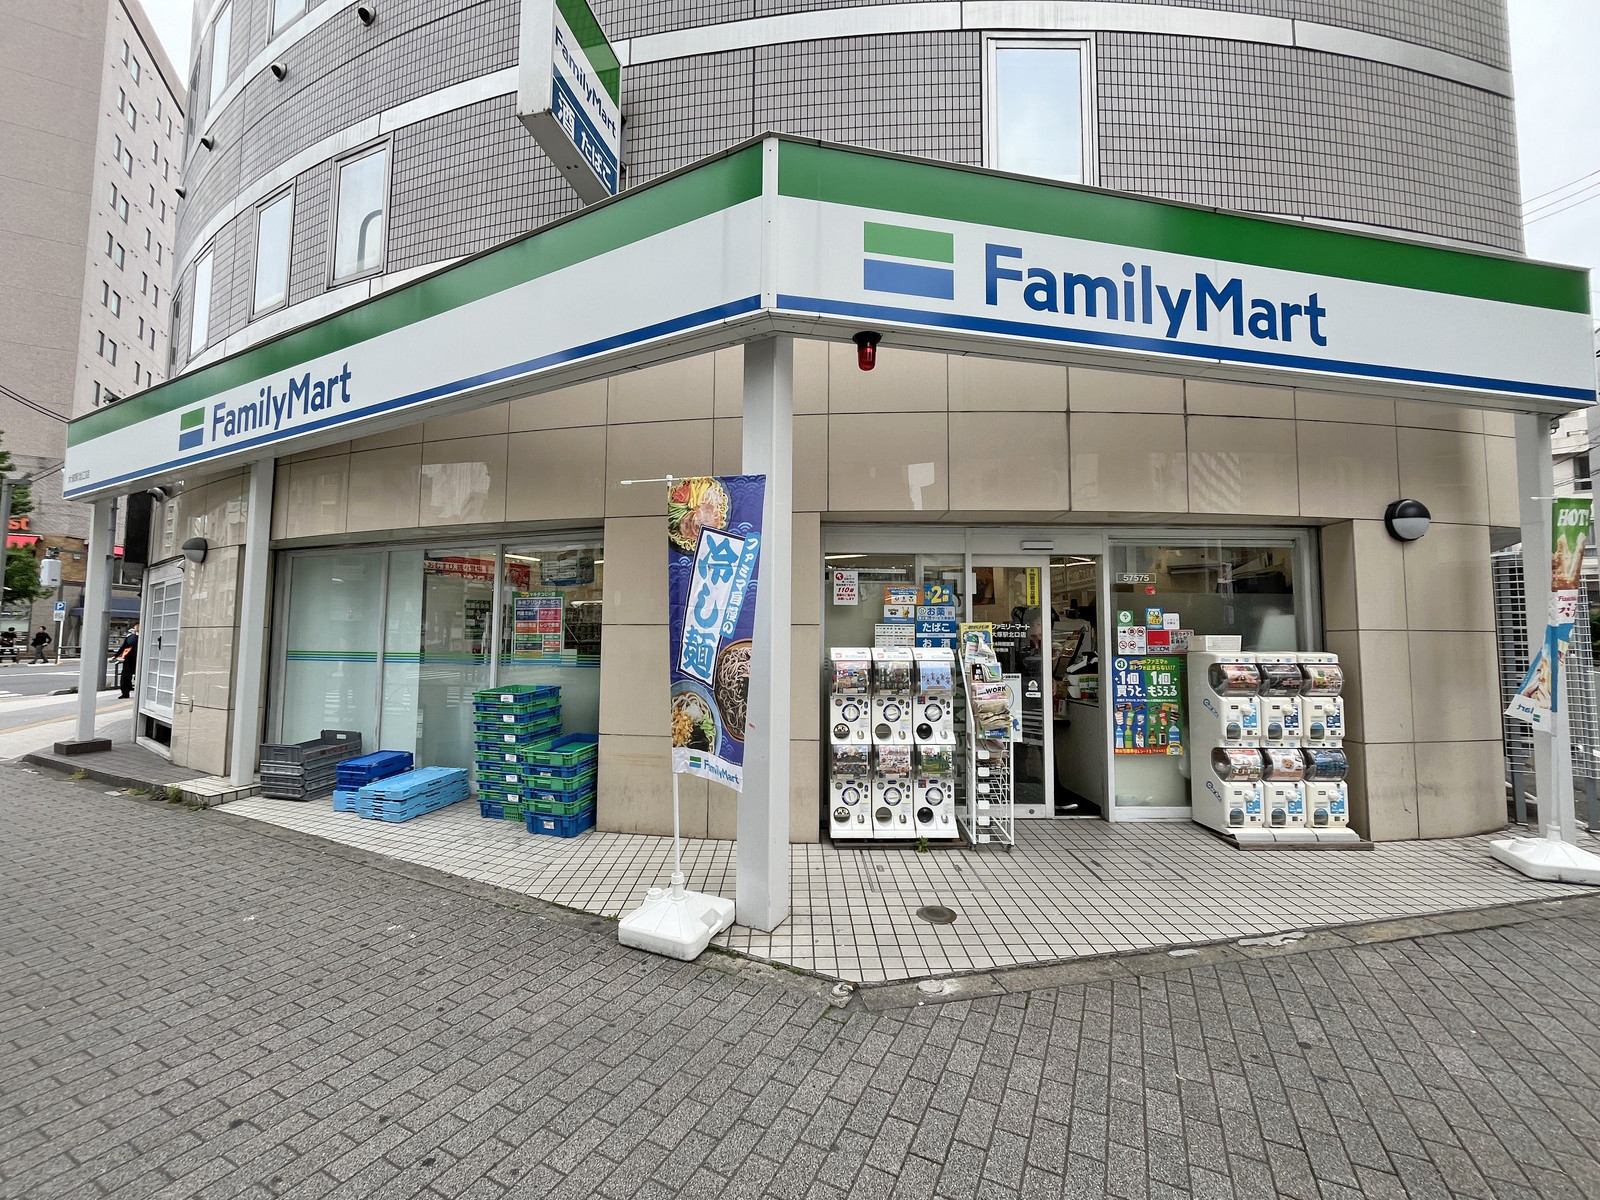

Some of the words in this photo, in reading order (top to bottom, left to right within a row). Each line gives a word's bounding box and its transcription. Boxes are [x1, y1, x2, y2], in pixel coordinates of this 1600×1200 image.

[555, 25, 617, 139] FamilyMart
[557, 91, 577, 141] 酒
[581, 131, 612, 189] たばこ
[985, 242, 1327, 347] FamilyMart
[211, 361, 352, 442] FamilyMart
[722, 537, 759, 635] ファミマ自慢の
[1123, 574, 1150, 582] 57575
[922, 622, 951, 633] たばこ
[991, 623, 1031, 631] ファミリーマート
[1119, 670, 1140, 685] 1個
[1150, 670, 1171, 685] 1個
[1147, 685, 1178, 697] もらえる
[703, 758, 740, 785] FamilyMart
